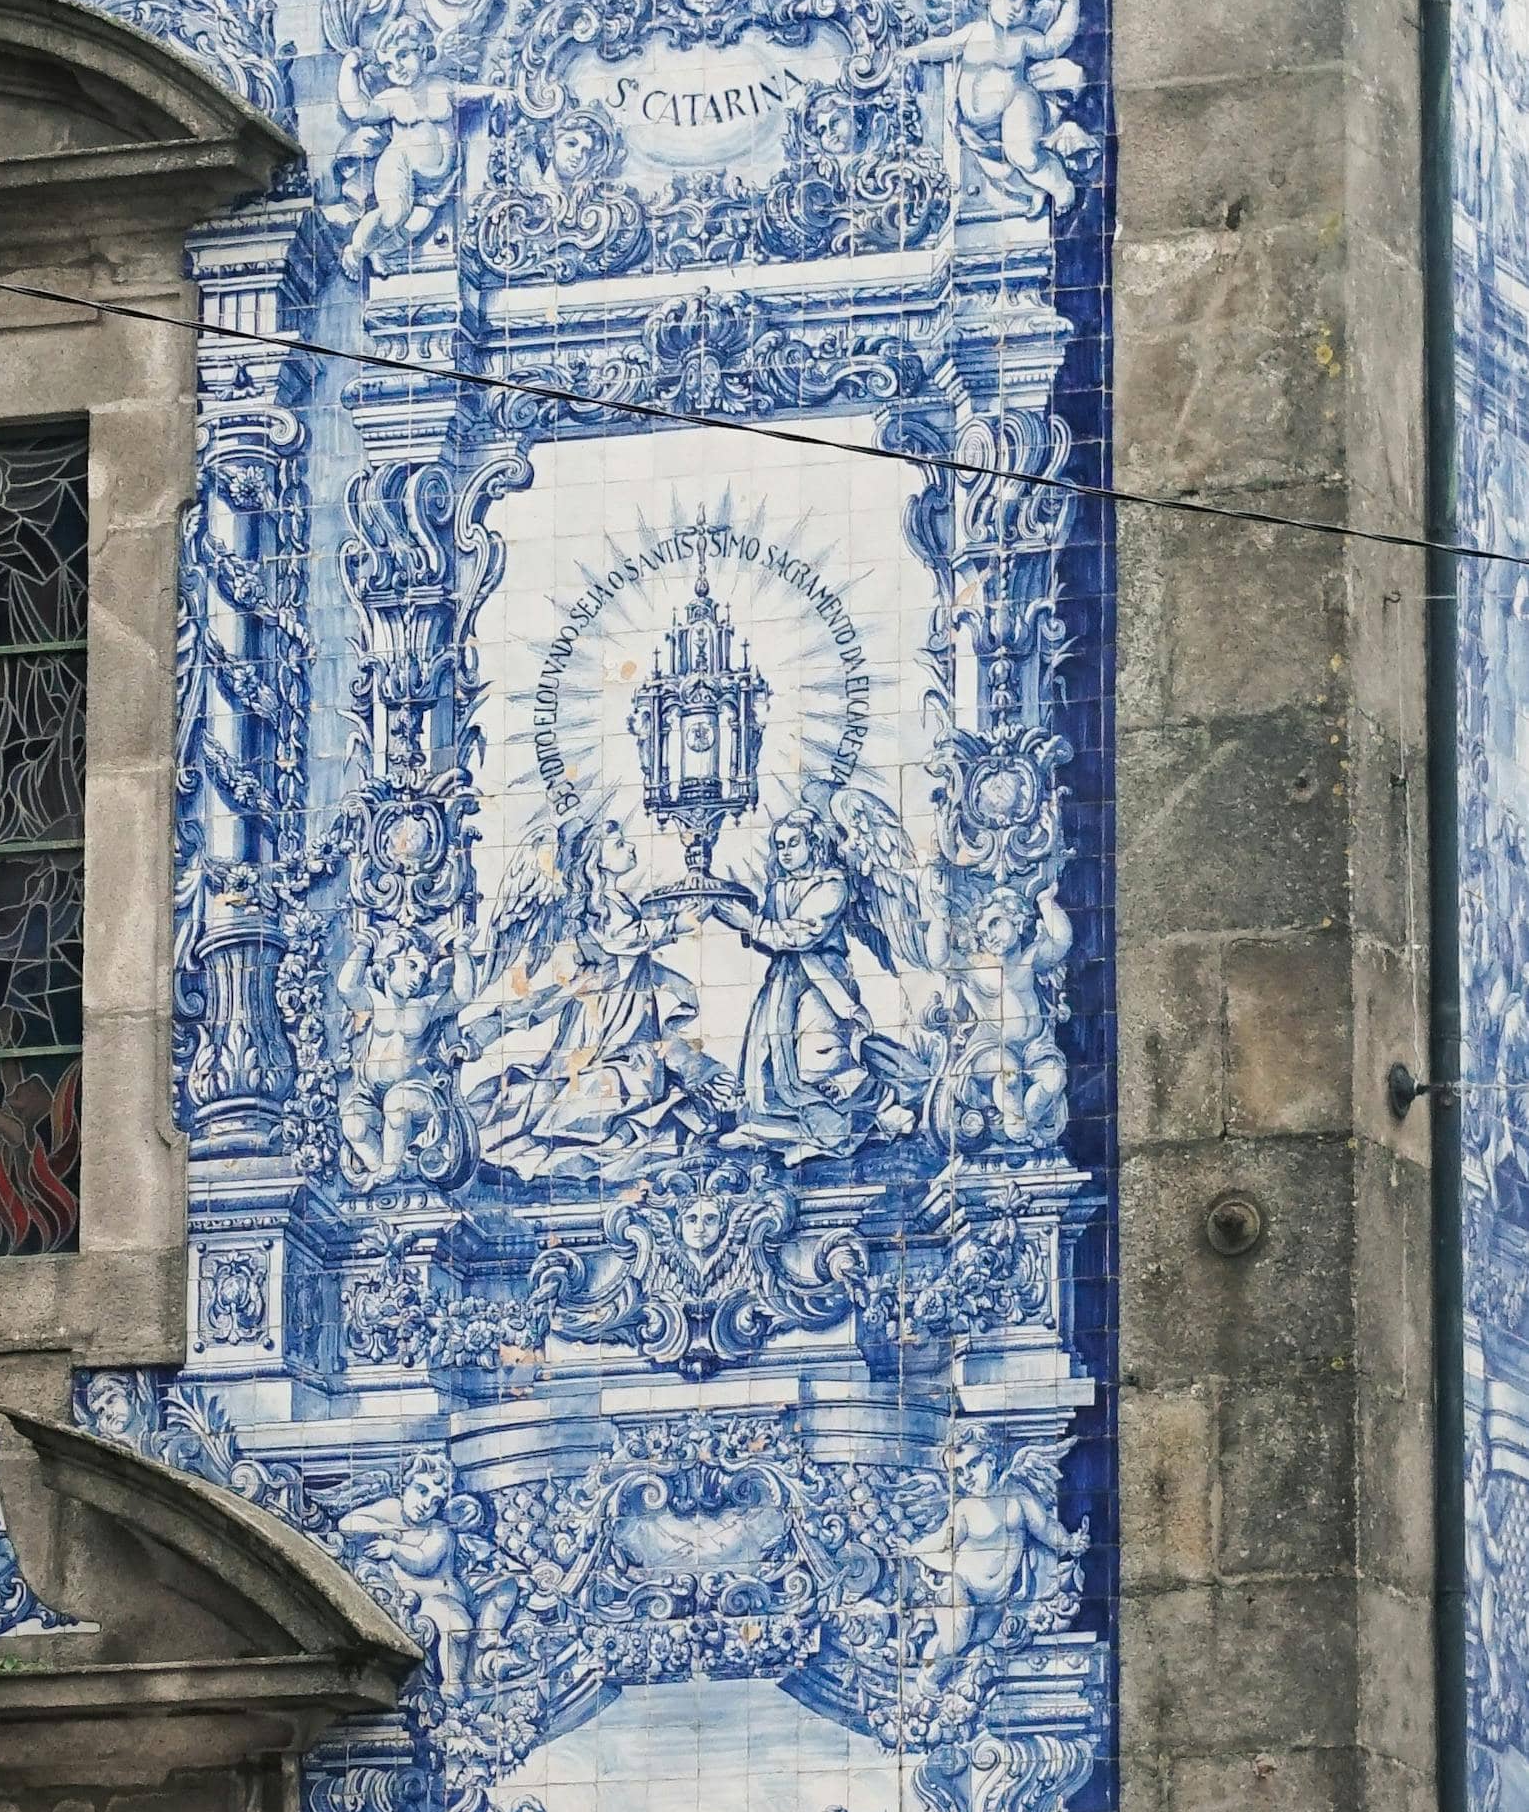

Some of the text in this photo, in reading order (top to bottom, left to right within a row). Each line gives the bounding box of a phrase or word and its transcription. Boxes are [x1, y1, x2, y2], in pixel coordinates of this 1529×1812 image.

[643, 68, 804, 126] CATARINA
[535, 624, 579, 713] LOUVADO
[570, 583, 615, 628] SEJA
[760, 544, 857, 645] SACRAMENTO
[839, 645, 867, 675] DA
